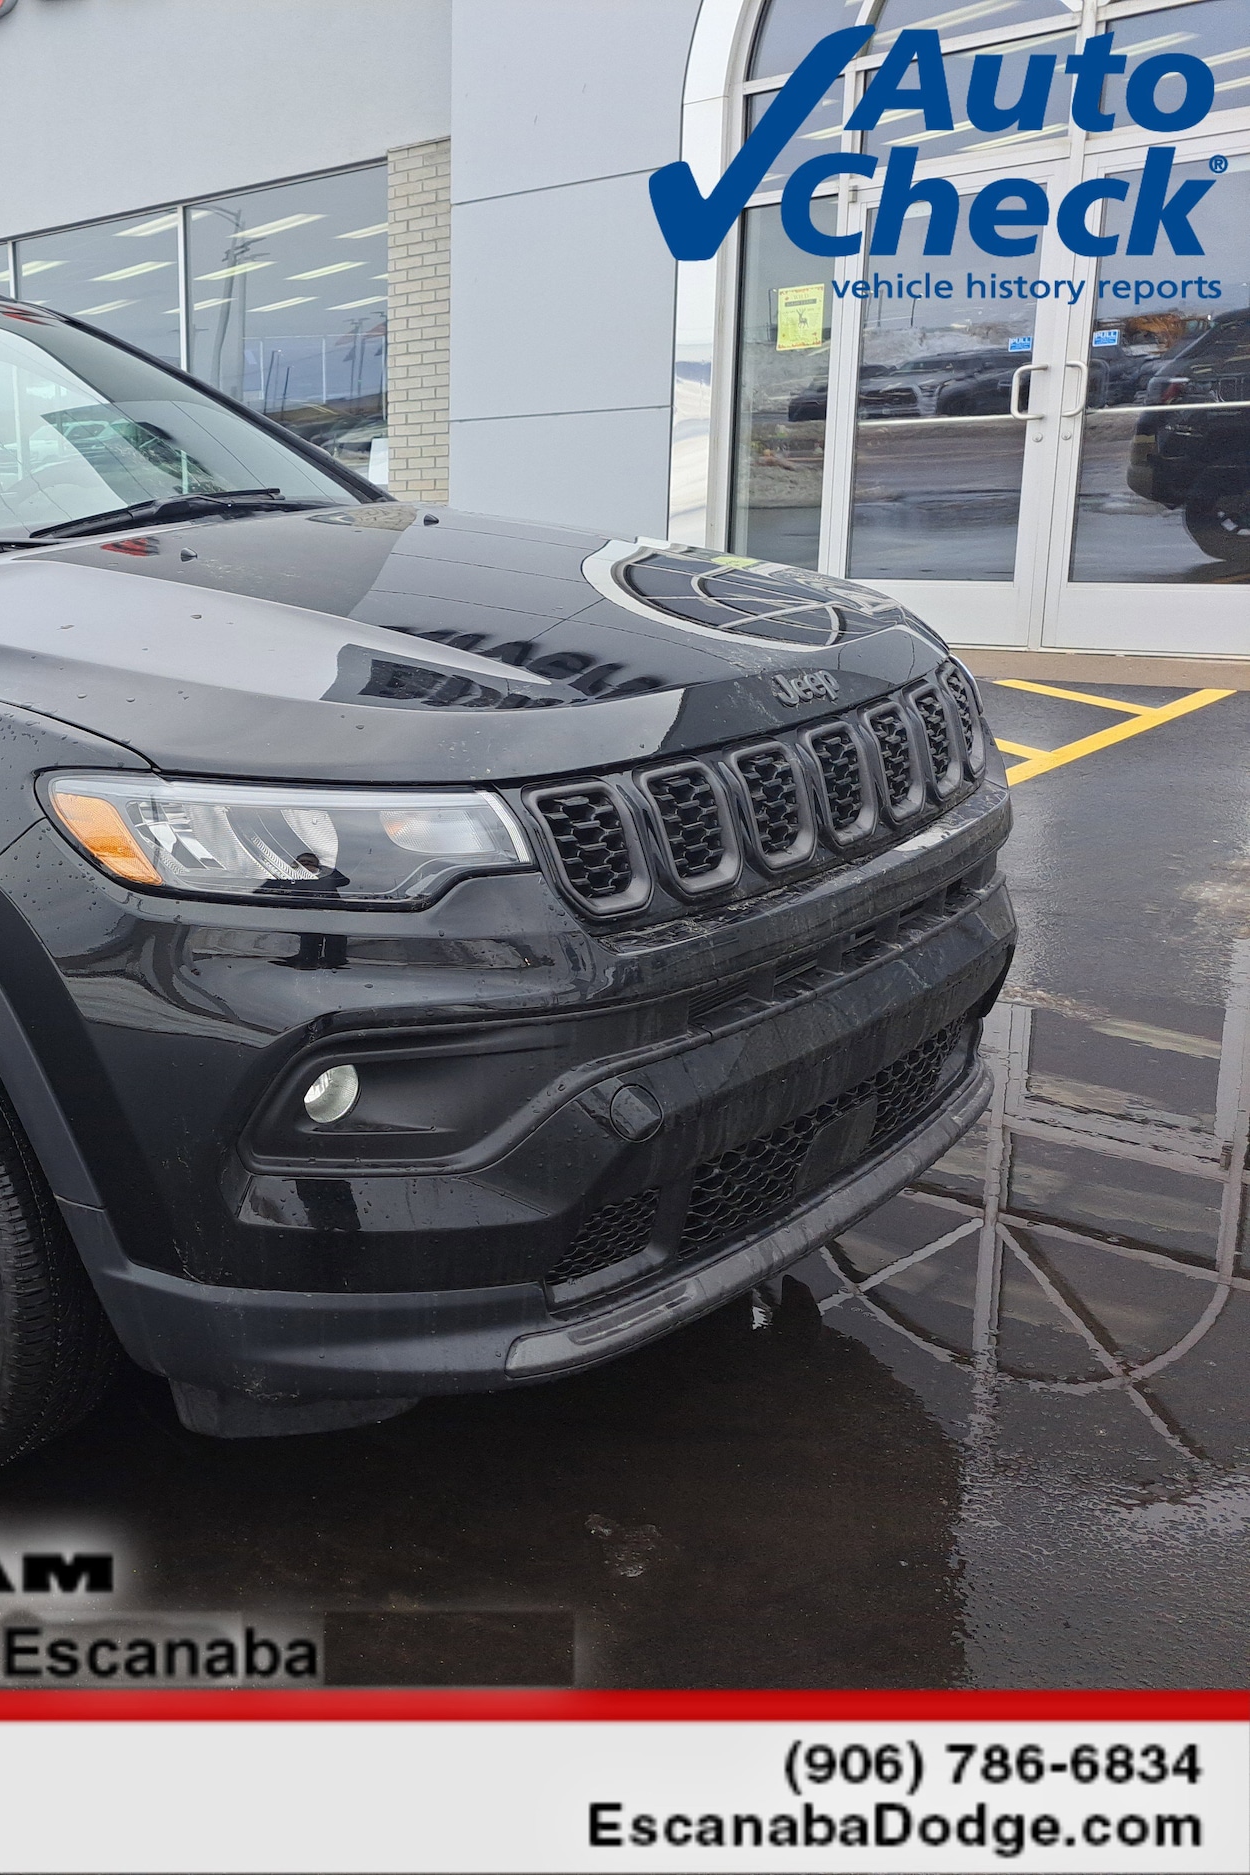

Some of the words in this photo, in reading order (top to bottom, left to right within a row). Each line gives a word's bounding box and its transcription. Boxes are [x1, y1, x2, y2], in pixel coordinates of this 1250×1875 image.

[1094, 330, 1117, 339] PULL
[1010, 337, 1031, 345] PULL
[771, 669, 840, 707] Jeep
